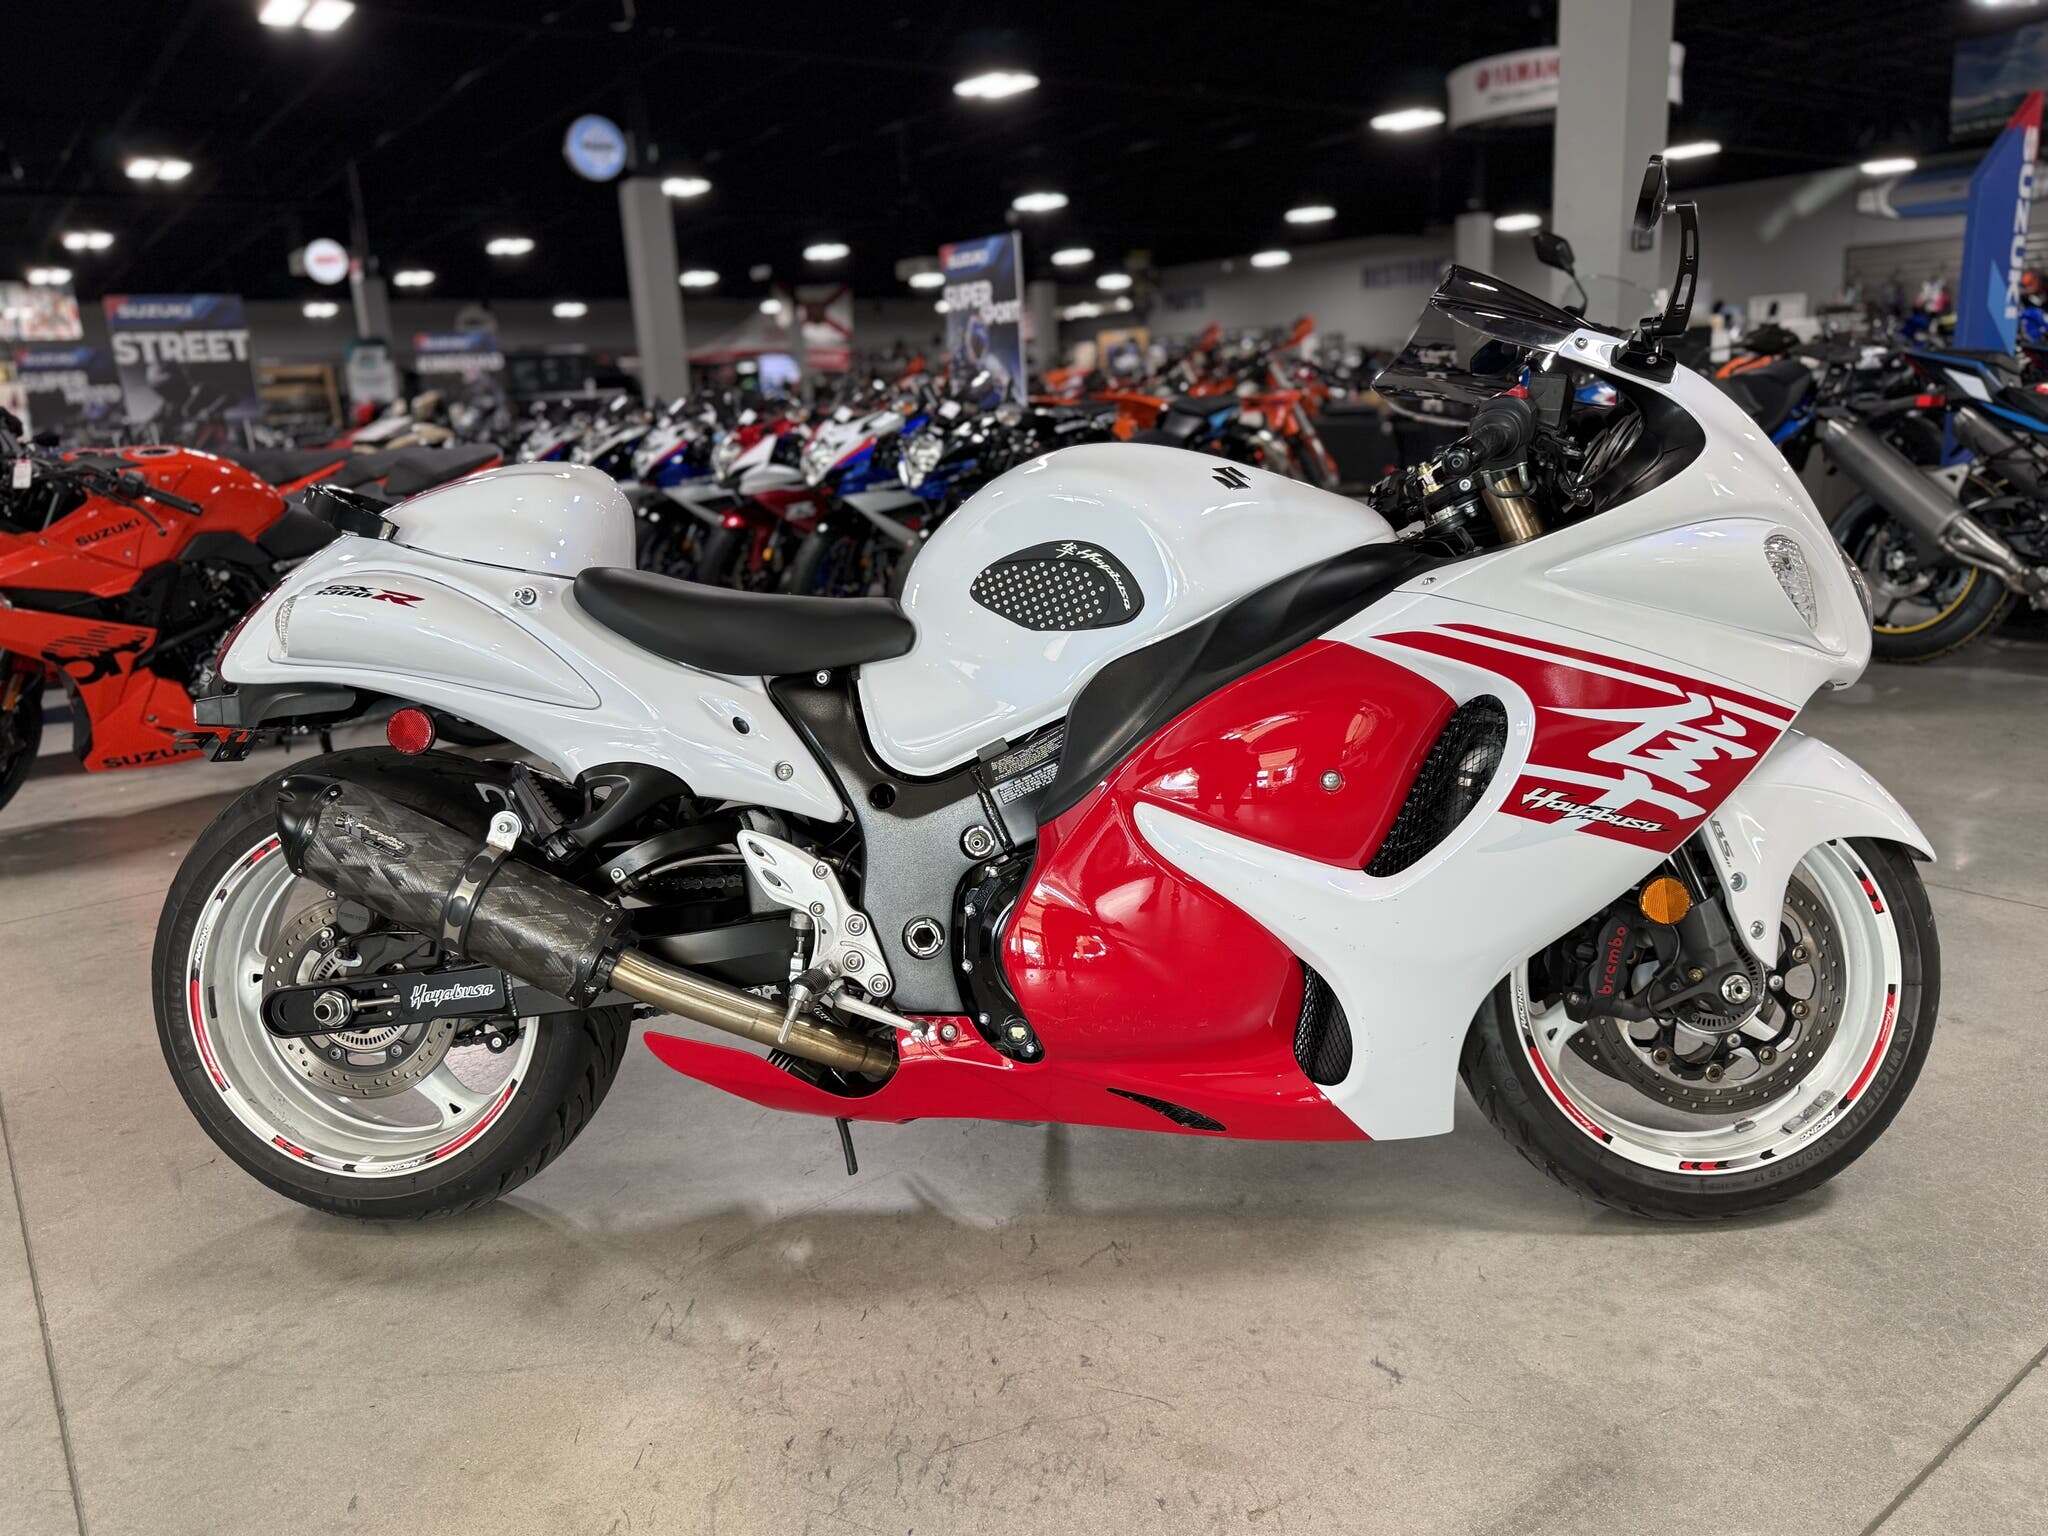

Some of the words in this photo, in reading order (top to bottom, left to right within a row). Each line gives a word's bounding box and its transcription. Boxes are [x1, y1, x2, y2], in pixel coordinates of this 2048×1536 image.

[1494, 57, 1560, 87] YAMAH
[2004, 126, 2040, 320] SUZUKI
[116, 302, 194, 320] SUZUKI
[112, 329, 249, 365] STREET
[75, 518, 141, 546] SUZUKI
[1076, 549, 1131, 611] Hayabusa
[102, 748, 189, 769] SUZU
[1521, 787, 1672, 833] Hayabusa
[1597, 925, 1628, 995] brembo
[410, 984, 495, 1010] Hayabusa
[1515, 984, 1529, 1030] RACING
[1839, 1051, 1902, 1141] MICHELIN
[1800, 1111, 1836, 1143] RACING
